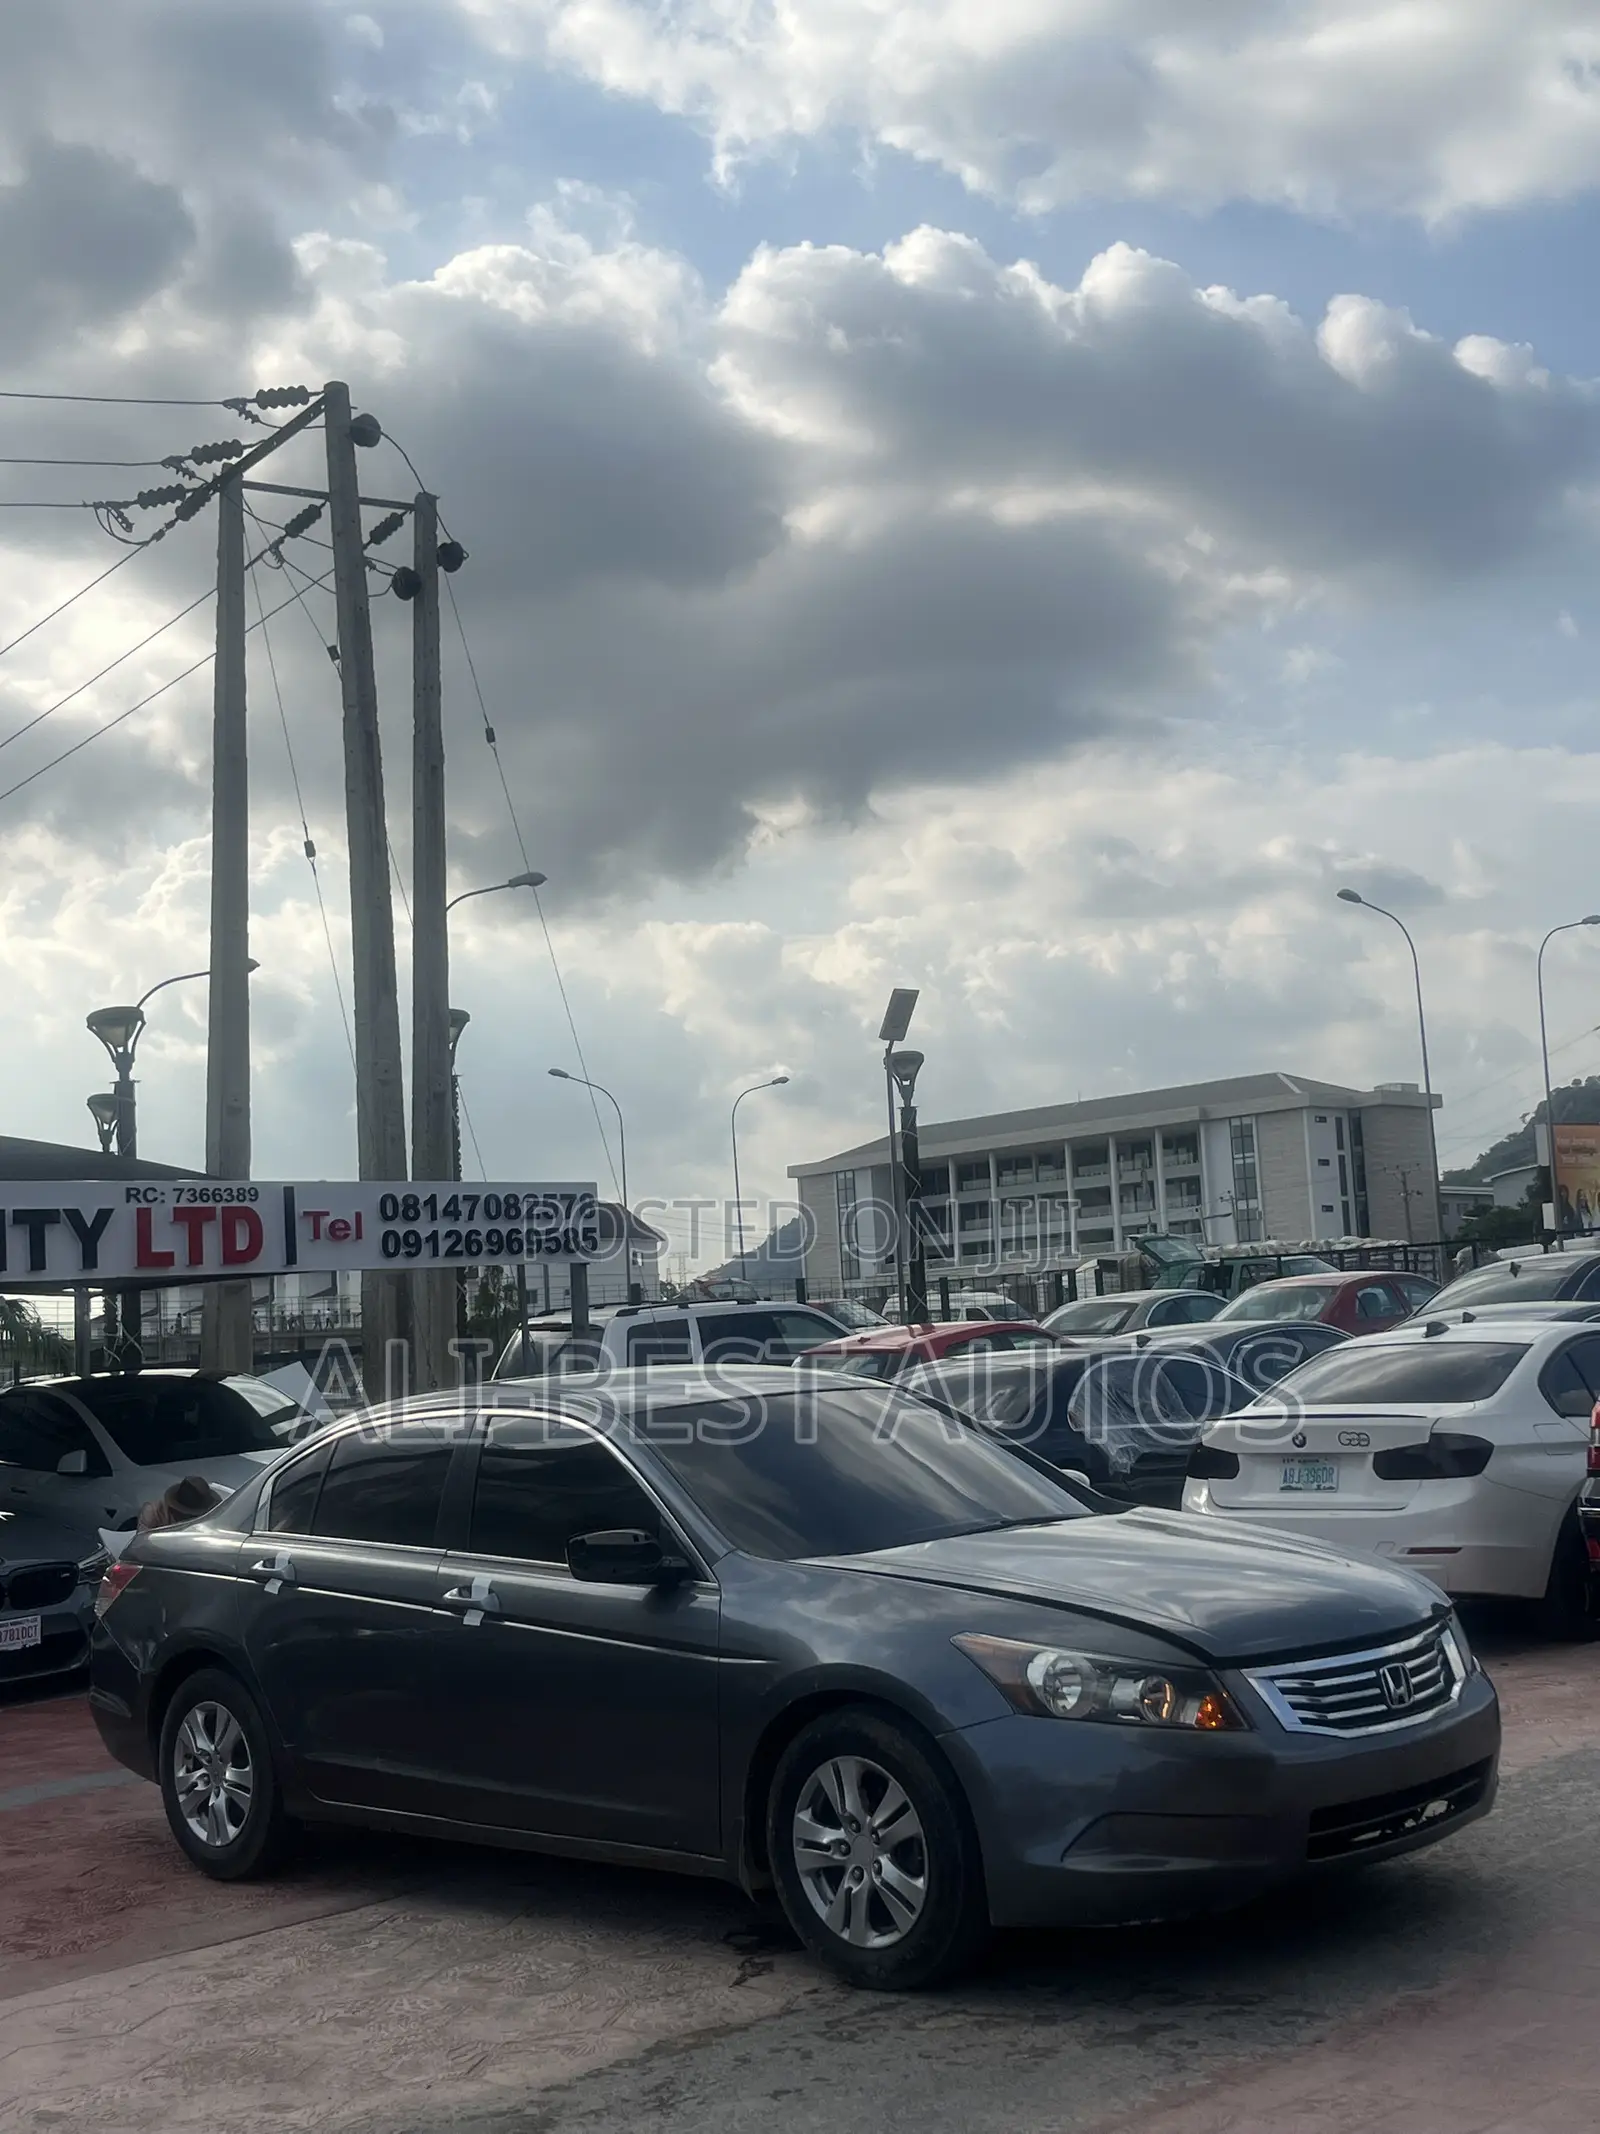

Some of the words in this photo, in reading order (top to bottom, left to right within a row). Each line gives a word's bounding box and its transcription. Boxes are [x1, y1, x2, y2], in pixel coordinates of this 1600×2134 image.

[125, 1187, 165, 1204] RC:
[172, 1186, 260, 1204] 7366389
[135, 1205, 264, 1268] LTD
[302, 1210, 363, 1242] Tel
[381, 1228, 598, 1258] 09126969585
